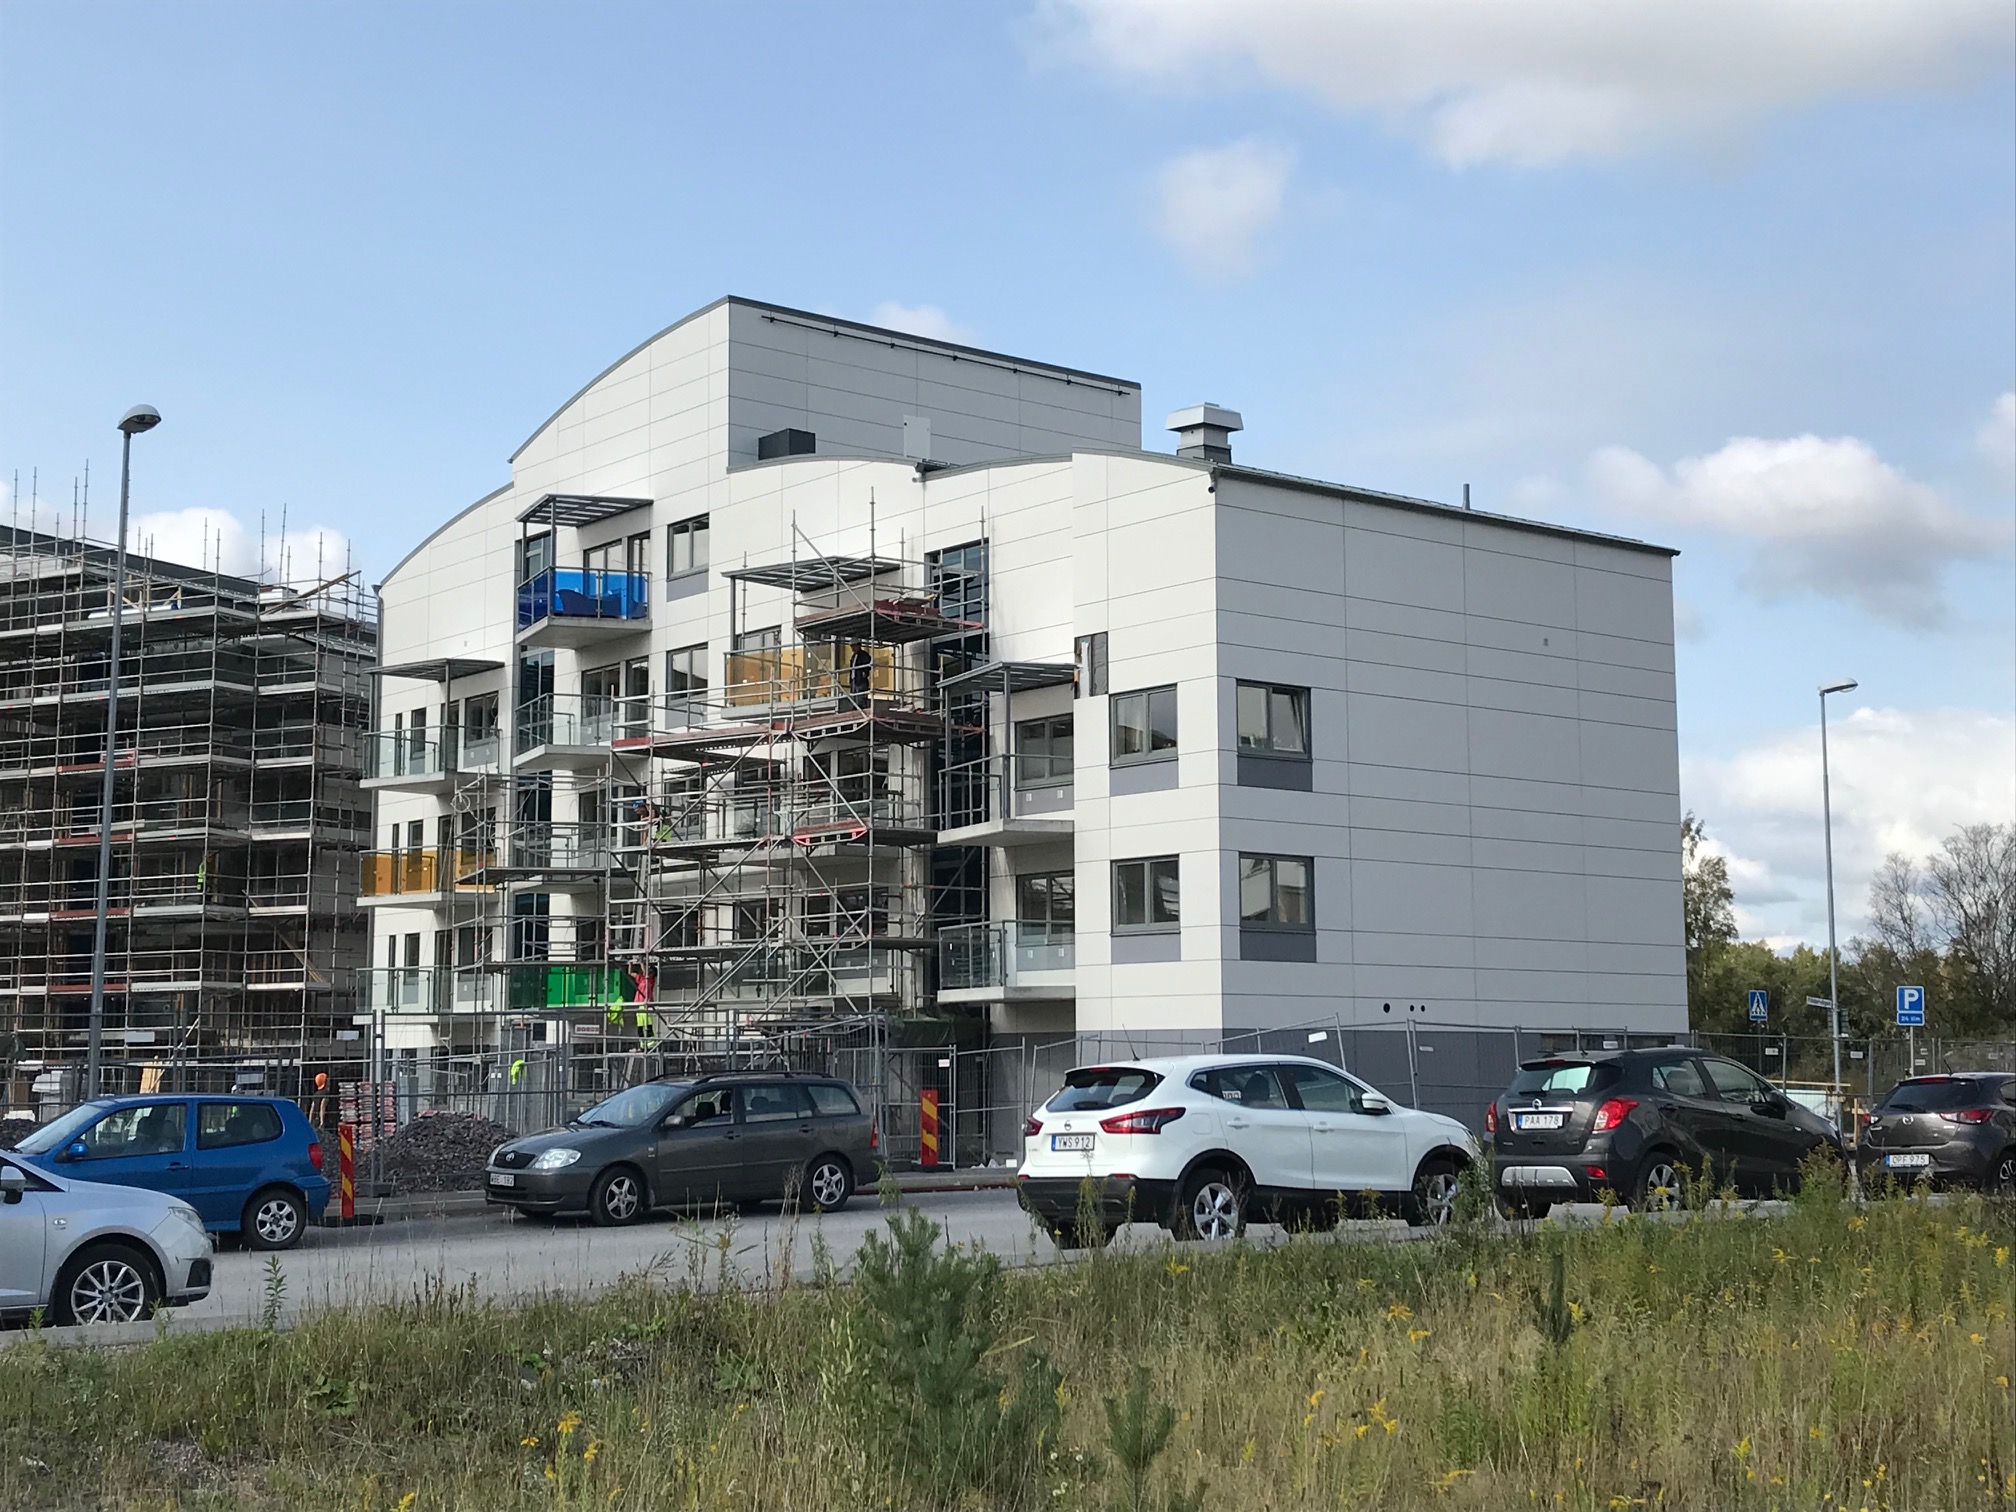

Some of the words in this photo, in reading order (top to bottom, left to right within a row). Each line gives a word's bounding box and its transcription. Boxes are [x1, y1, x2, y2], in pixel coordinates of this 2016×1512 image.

[1904, 989, 1919, 1010] P
[1524, 1115, 1540, 1125] PAA
[1058, 1136, 1073, 1148] YWS
[1074, 1136, 1091, 1148] 912
[1909, 1155, 1926, 1164] 975
